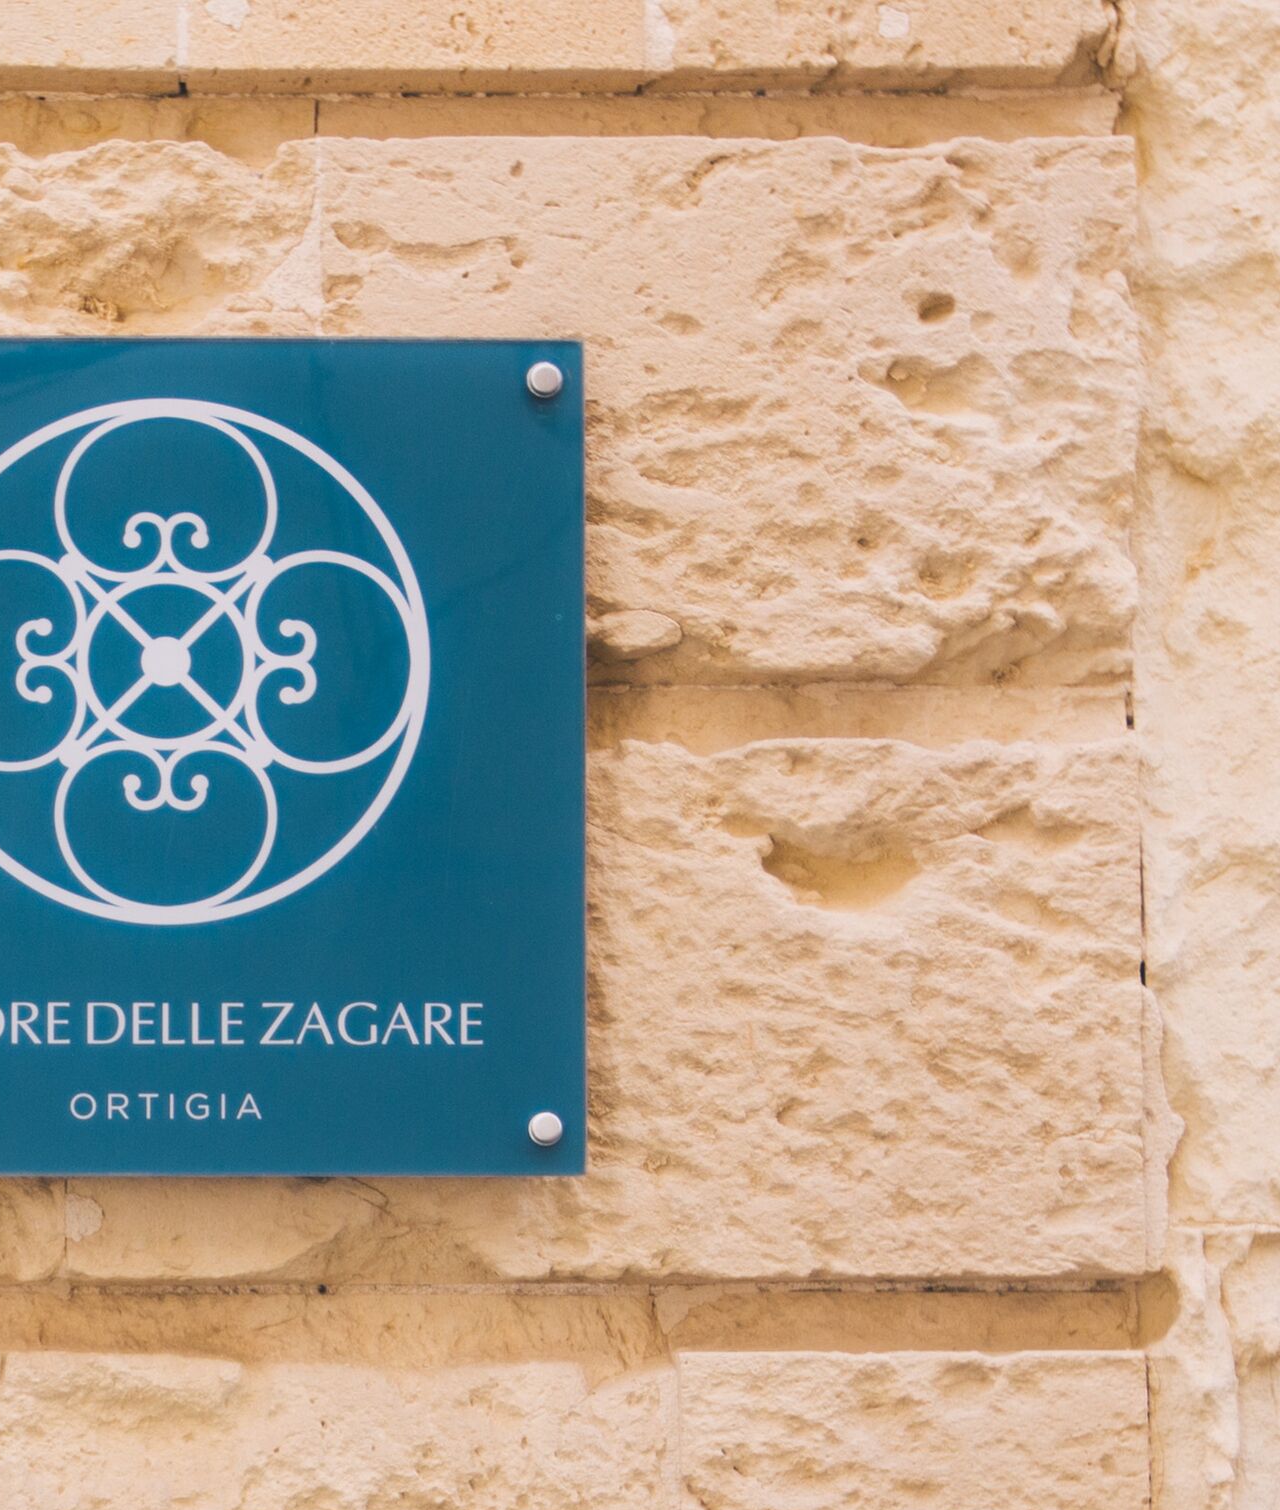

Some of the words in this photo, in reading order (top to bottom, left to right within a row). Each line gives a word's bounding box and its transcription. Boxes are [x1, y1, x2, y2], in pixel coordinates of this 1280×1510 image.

[85, 1001, 245, 1045] DELLE
[258, 1001, 484, 1046] ZAGARE
[69, 1092, 263, 1120] ORTIGIA
